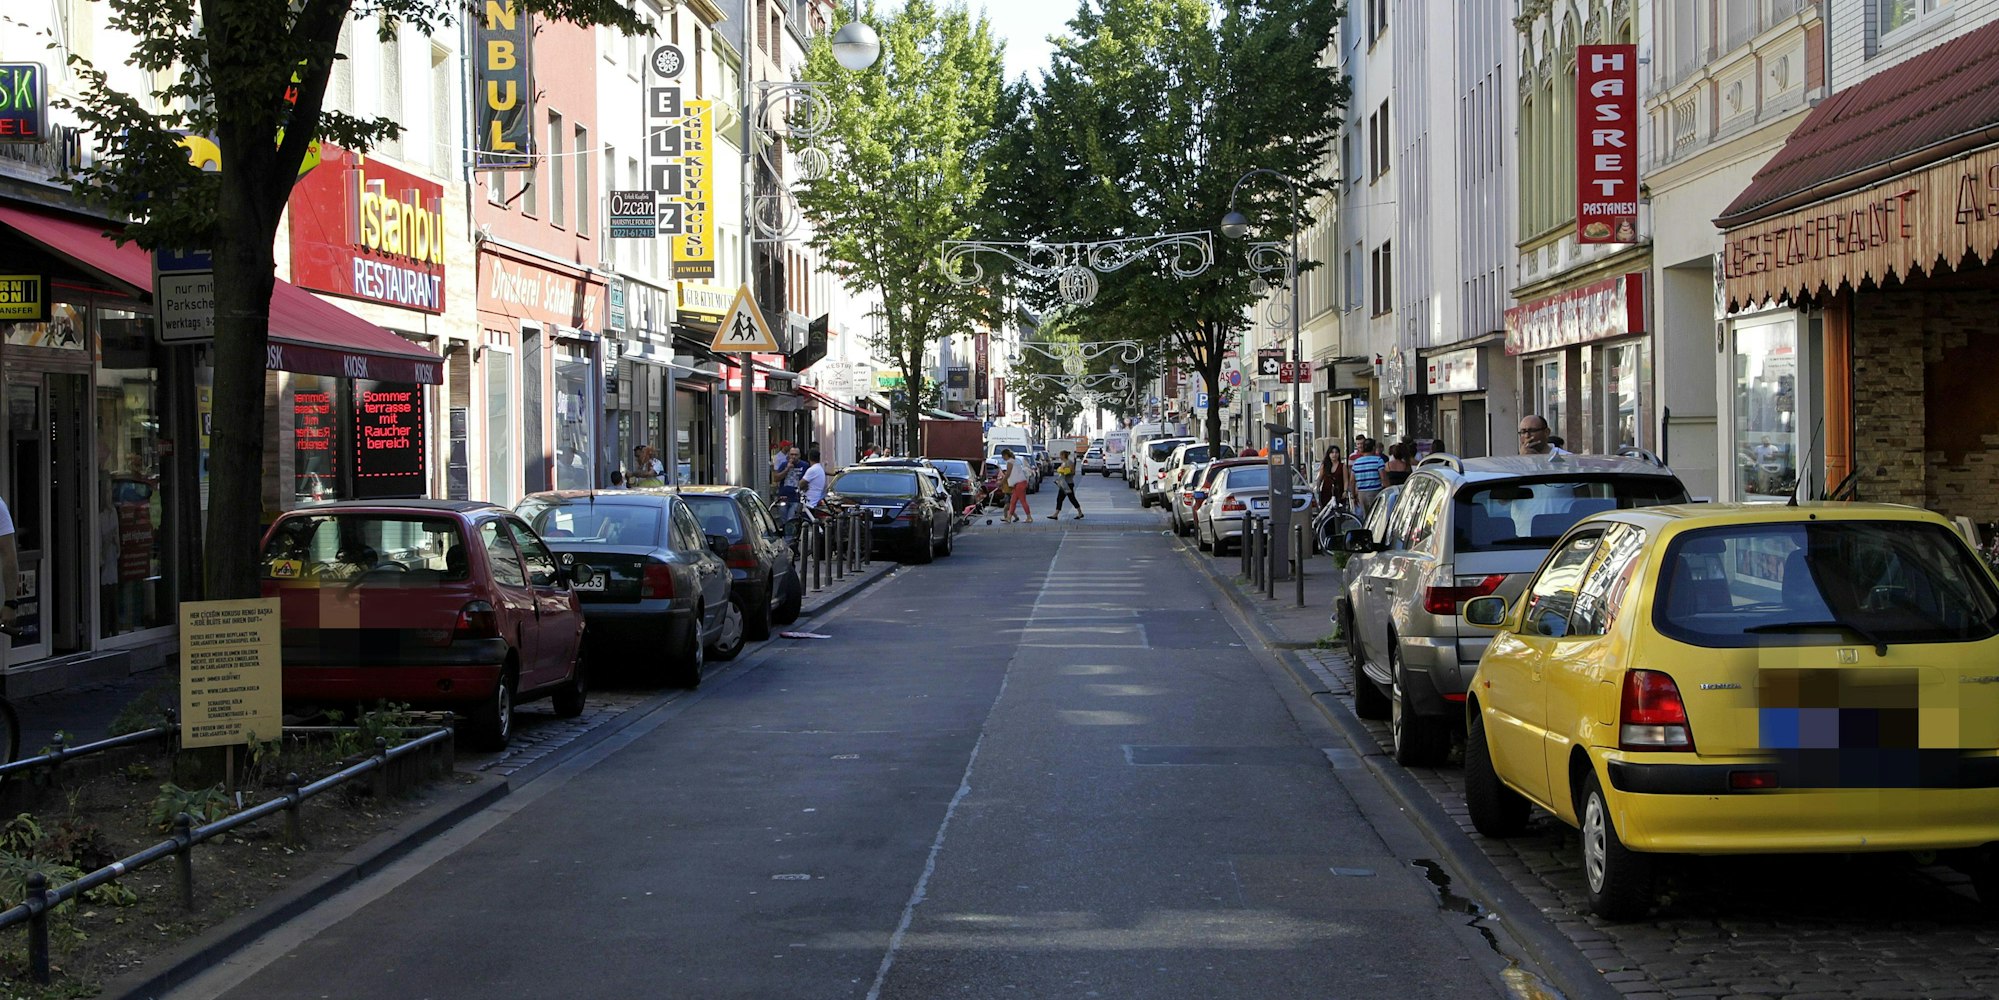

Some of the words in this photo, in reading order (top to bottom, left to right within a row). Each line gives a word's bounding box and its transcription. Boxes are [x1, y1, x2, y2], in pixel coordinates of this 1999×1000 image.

[1590, 53, 1627, 197] HASRET
[658, 92, 676, 229] ELIZ
[612, 191, 655, 215] Özcan
[1724, 190, 1920, 279] RESTAURANT
[353, 256, 443, 309] RESTAURANT
[491, 258, 542, 309] Druckerei
[176, 285, 192, 295] nur
[165, 317, 201, 331] werktags
[343, 355, 369, 378] KIOSK
[414, 363, 434, 383] KIOSK
[1281, 369, 1308, 377] STR
[363, 391, 412, 403] Sommer
[364, 402, 411, 414] terrasse
[379, 413, 399, 425] mit
[364, 425, 412, 437] Raucher
[366, 437, 410, 450] bereich
[1274, 437, 1284, 451] P
